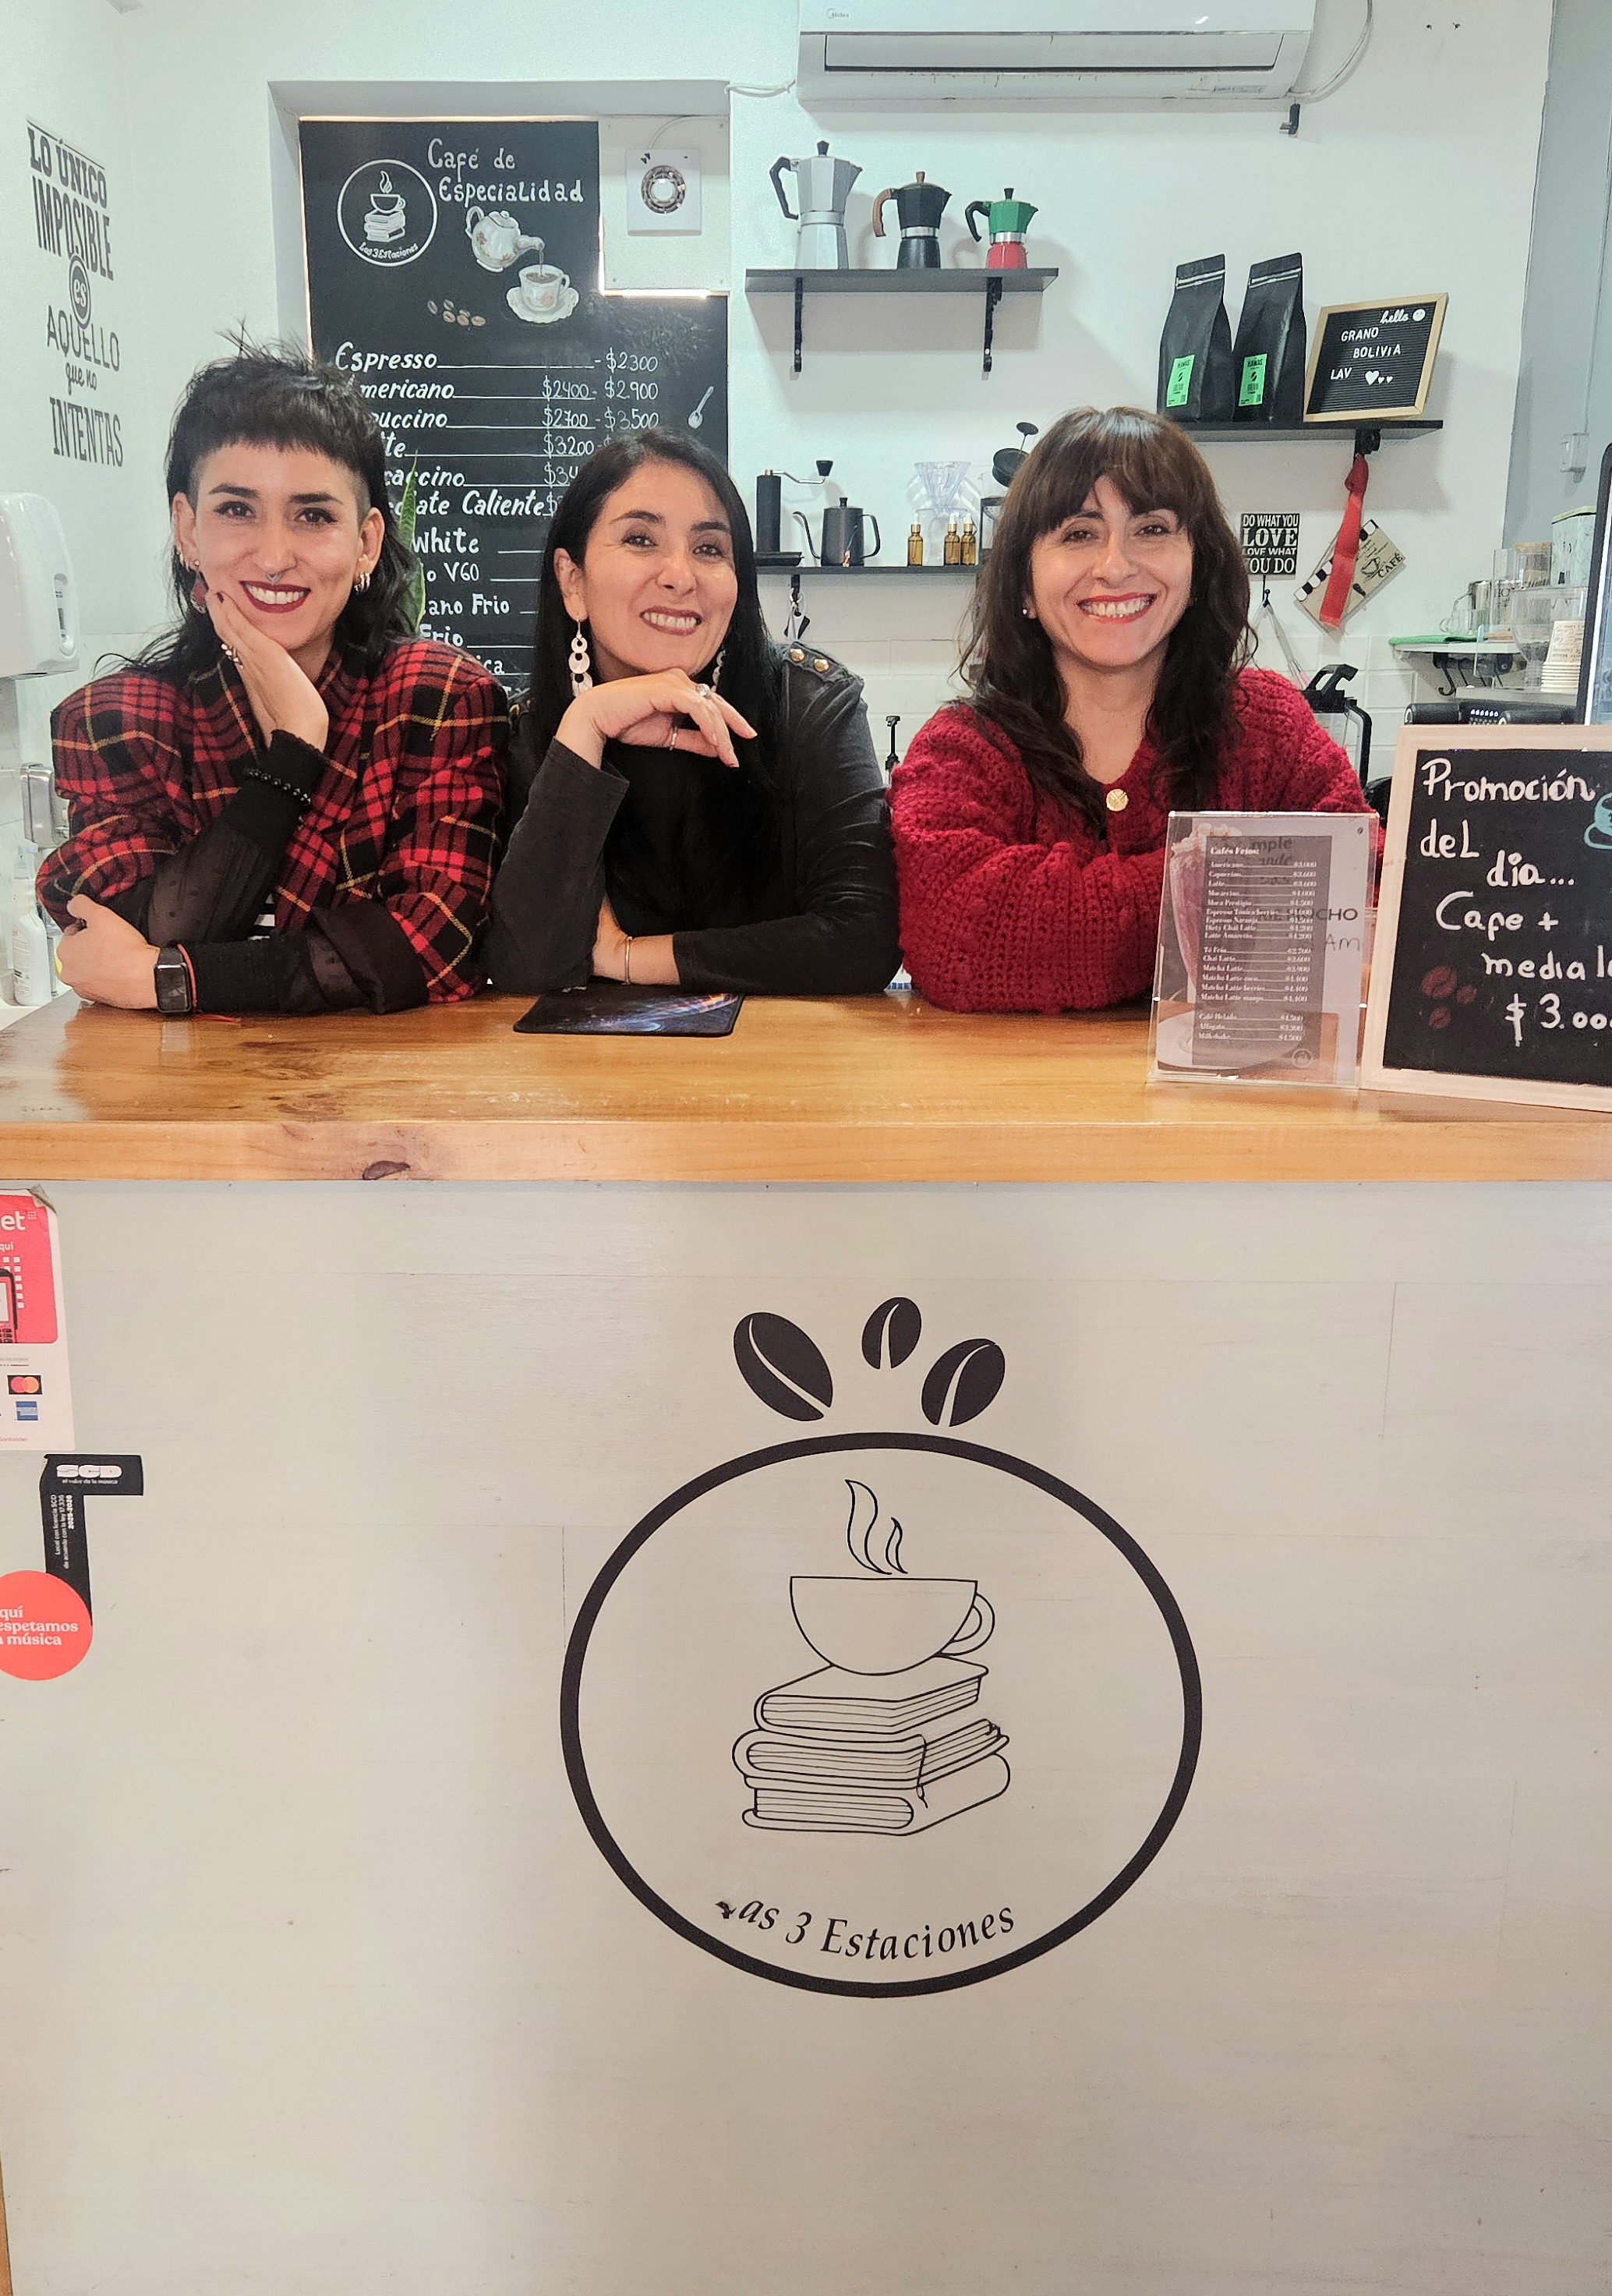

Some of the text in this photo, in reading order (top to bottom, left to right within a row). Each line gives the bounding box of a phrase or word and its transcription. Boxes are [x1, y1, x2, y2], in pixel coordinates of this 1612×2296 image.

[27, 126, 52, 178] LO
[428, 138, 515, 183] Café de
[32, 175, 114, 281] IMPOSIBLE
[73, 278, 87, 308] es
[1379, 309, 1409, 324] hello
[47, 305, 120, 372] AQUELLO
[1341, 327, 1379, 341] GRANO
[335, 341, 437, 373] Espresso
[1352, 344, 1401, 359] BOLIVIA
[65, 362, 97, 395] que no
[1331, 366, 1352, 380] LAV
[348, 374, 454, 399] mericano
[49, 396, 123, 467] INTENTAS
[461, 489, 544, 516] Caliente
[1243, 514, 1299, 527] DO WHAT YOU
[1242, 527, 1298, 547] LOVE
[1268, 547, 1297, 556] WHAT
[444, 561, 479, 582] V60
[1273, 557, 1295, 574] DO
[1422, 758, 1596, 801] Promoción
[6, 1633, 62, 1645] música
[786, 1912, 812, 1944] 3
[820, 1905, 1015, 1961] Estaciones
